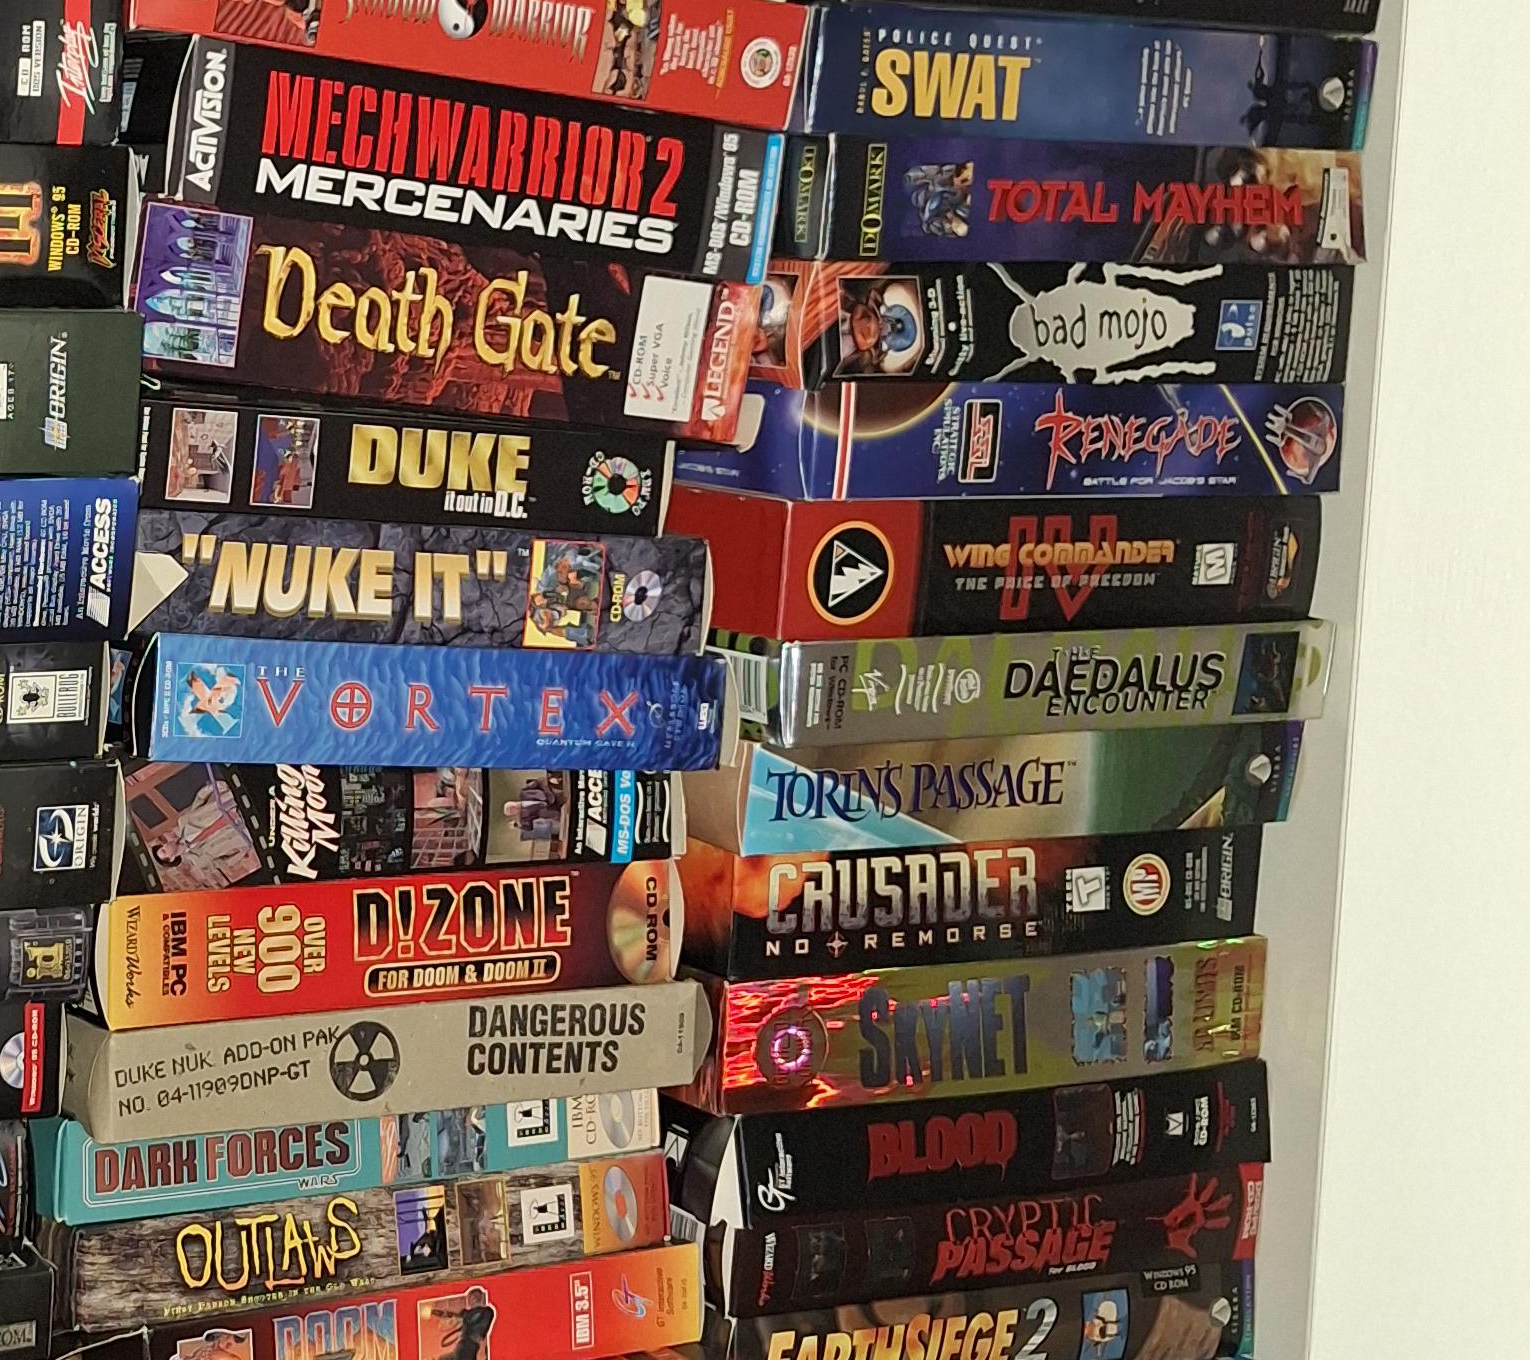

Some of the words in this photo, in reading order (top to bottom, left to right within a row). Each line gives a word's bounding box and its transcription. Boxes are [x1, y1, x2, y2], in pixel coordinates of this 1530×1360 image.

[870, 46, 1032, 122] SWAT
[261, 69, 653, 208] MECHWARRIOR
[653, 137, 684, 216] 2
[253, 157, 680, 256] MERCENARIES
[985, 179, 1123, 226] TOTAL
[1131, 181, 1305, 228] MAYHEM
[255, 243, 456, 365] Death
[473, 269, 620, 382] Gate
[1031, 300, 1087, 350] bad
[1096, 296, 1168, 353] mojo
[347, 424, 534, 494] DUKE
[1034, 387, 1243, 490] RENEGADE
[88, 496, 113, 590] ACCESS
[254, 678, 642, 739] VORTEX
[1002, 652, 1227, 700] DAEDALUS
[1045, 687, 1208, 717] ENCOUNTER
[765, 757, 905, 823] TORIN'S
[910, 756, 1068, 811] PASSAGE
[766, 846, 1039, 936] CRUSADER
[206, 914, 232, 994] LEVELS
[256, 904, 302, 996] 900
[302, 915, 326, 973] OVER
[765, 938, 812, 957] NO
[863, 920, 1040, 951] REMORSE
[467, 1002, 646, 1040] DANGEROUS
[113, 1059, 169, 1091] DUKE
[221, 1034, 297, 1065] ADD-ON
[300, 1026, 340, 1050] PAK
[466, 1040, 619, 1077] CONTENTS
[93, 1138, 199, 1196] DARK
[205, 1122, 353, 1181] FORCES
[867, 1109, 1019, 1181] BLOOD
[929, 1221, 1117, 1286] PASSAGE
